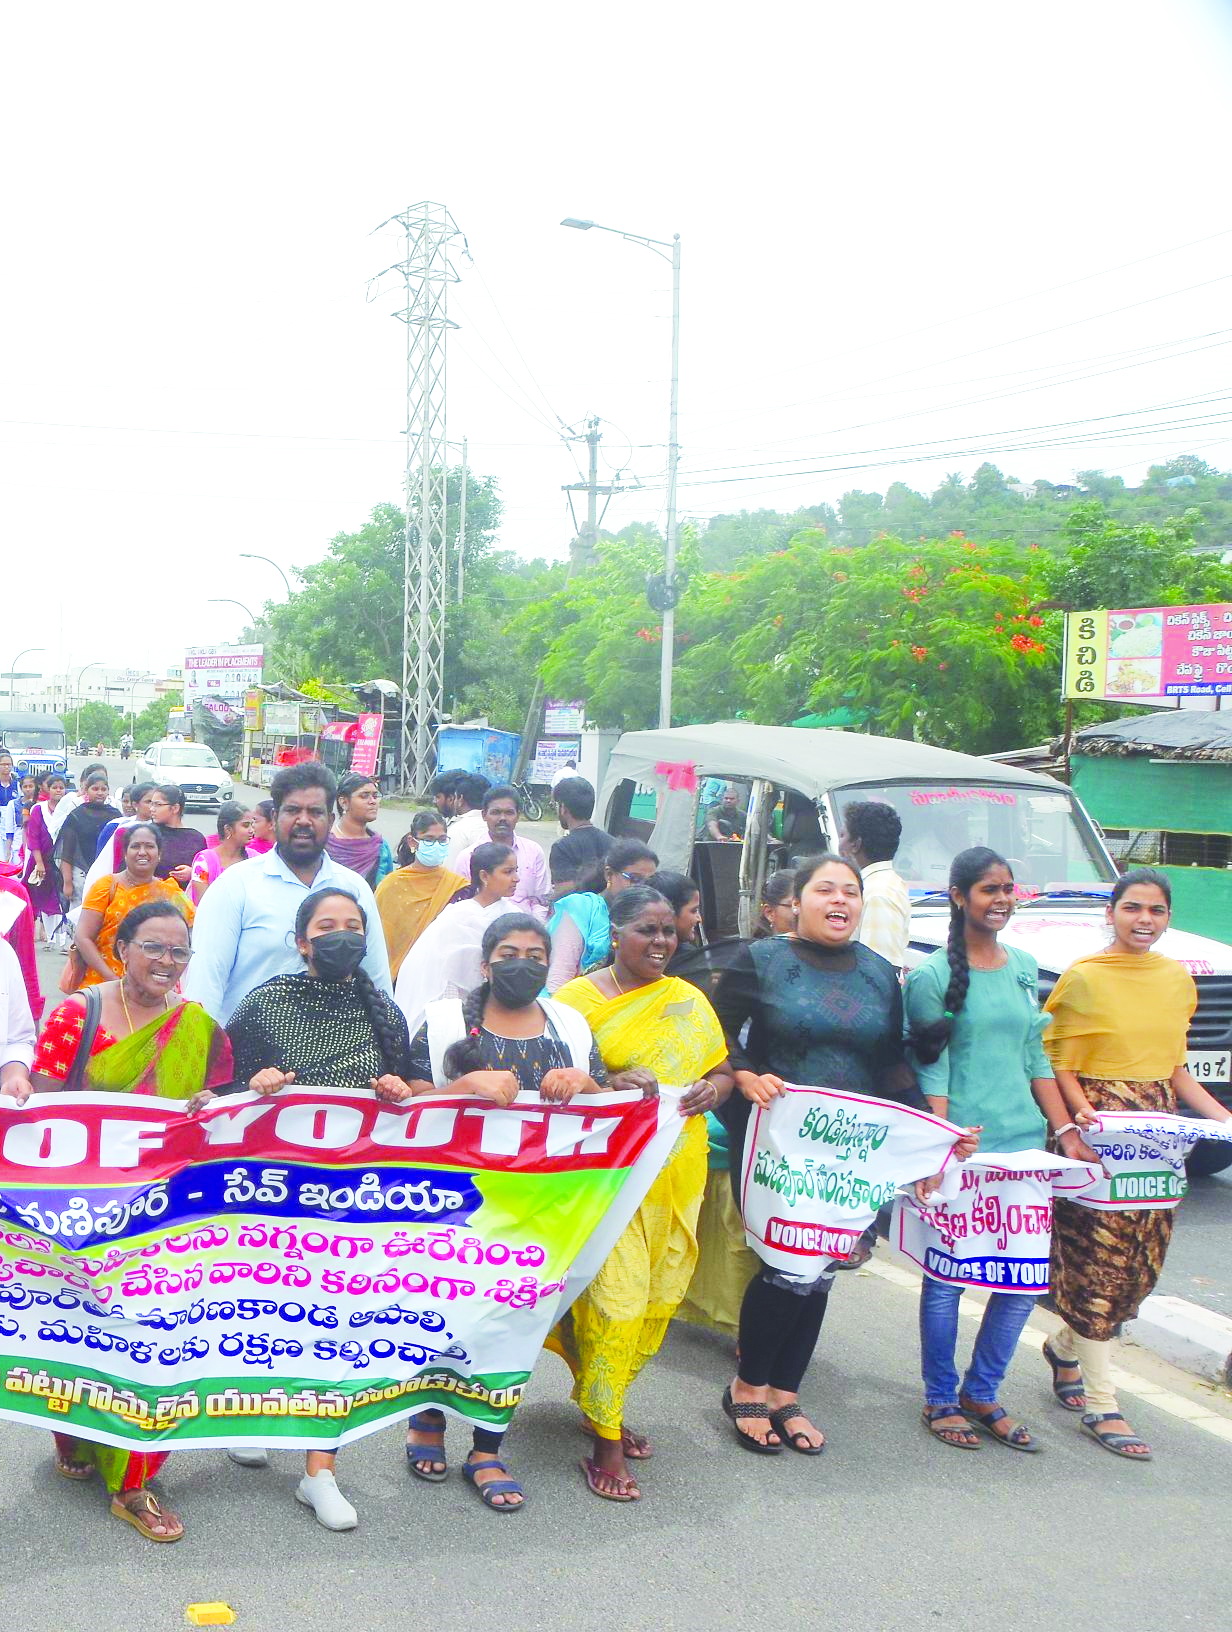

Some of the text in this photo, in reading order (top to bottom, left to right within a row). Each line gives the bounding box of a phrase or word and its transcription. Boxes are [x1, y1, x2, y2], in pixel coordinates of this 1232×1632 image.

[199, 657, 217, 668] LEADER
[225, 655, 258, 667] PLACEMENTS
[1167, 685, 1189, 694] BRTS
[1190, 685, 1214, 694] Road,
[2, 1117, 167, 1168] OF
[198, 1103, 624, 1157] YOUTH
[223, 1167, 289, 1206] సేవ్
[299, 1172, 465, 1214] ఇండియా
[1116, 1175, 1166, 1198] VOICE
[771, 1221, 821, 1251] VOICE
[971, 1192, 1056, 1250] కల్పించా
[238, 1223, 374, 1260] నగ్నంగా
[382, 1230, 546, 1268] ఊరేగించి
[121, 1262, 204, 1298] చేసిన
[209, 1261, 312, 1288] వారిని
[928, 1251, 982, 1280] VOICE
[986, 1260, 1006, 1283] OF
[136, 1298, 338, 1331] మారణకాండ
[349, 1303, 454, 1340] ఆపాలి,
[37, 1319, 210, 1366] మహిళలకు
[218, 1331, 304, 1369] రక్షణ
[205, 1389, 353, 1418] యువతను
